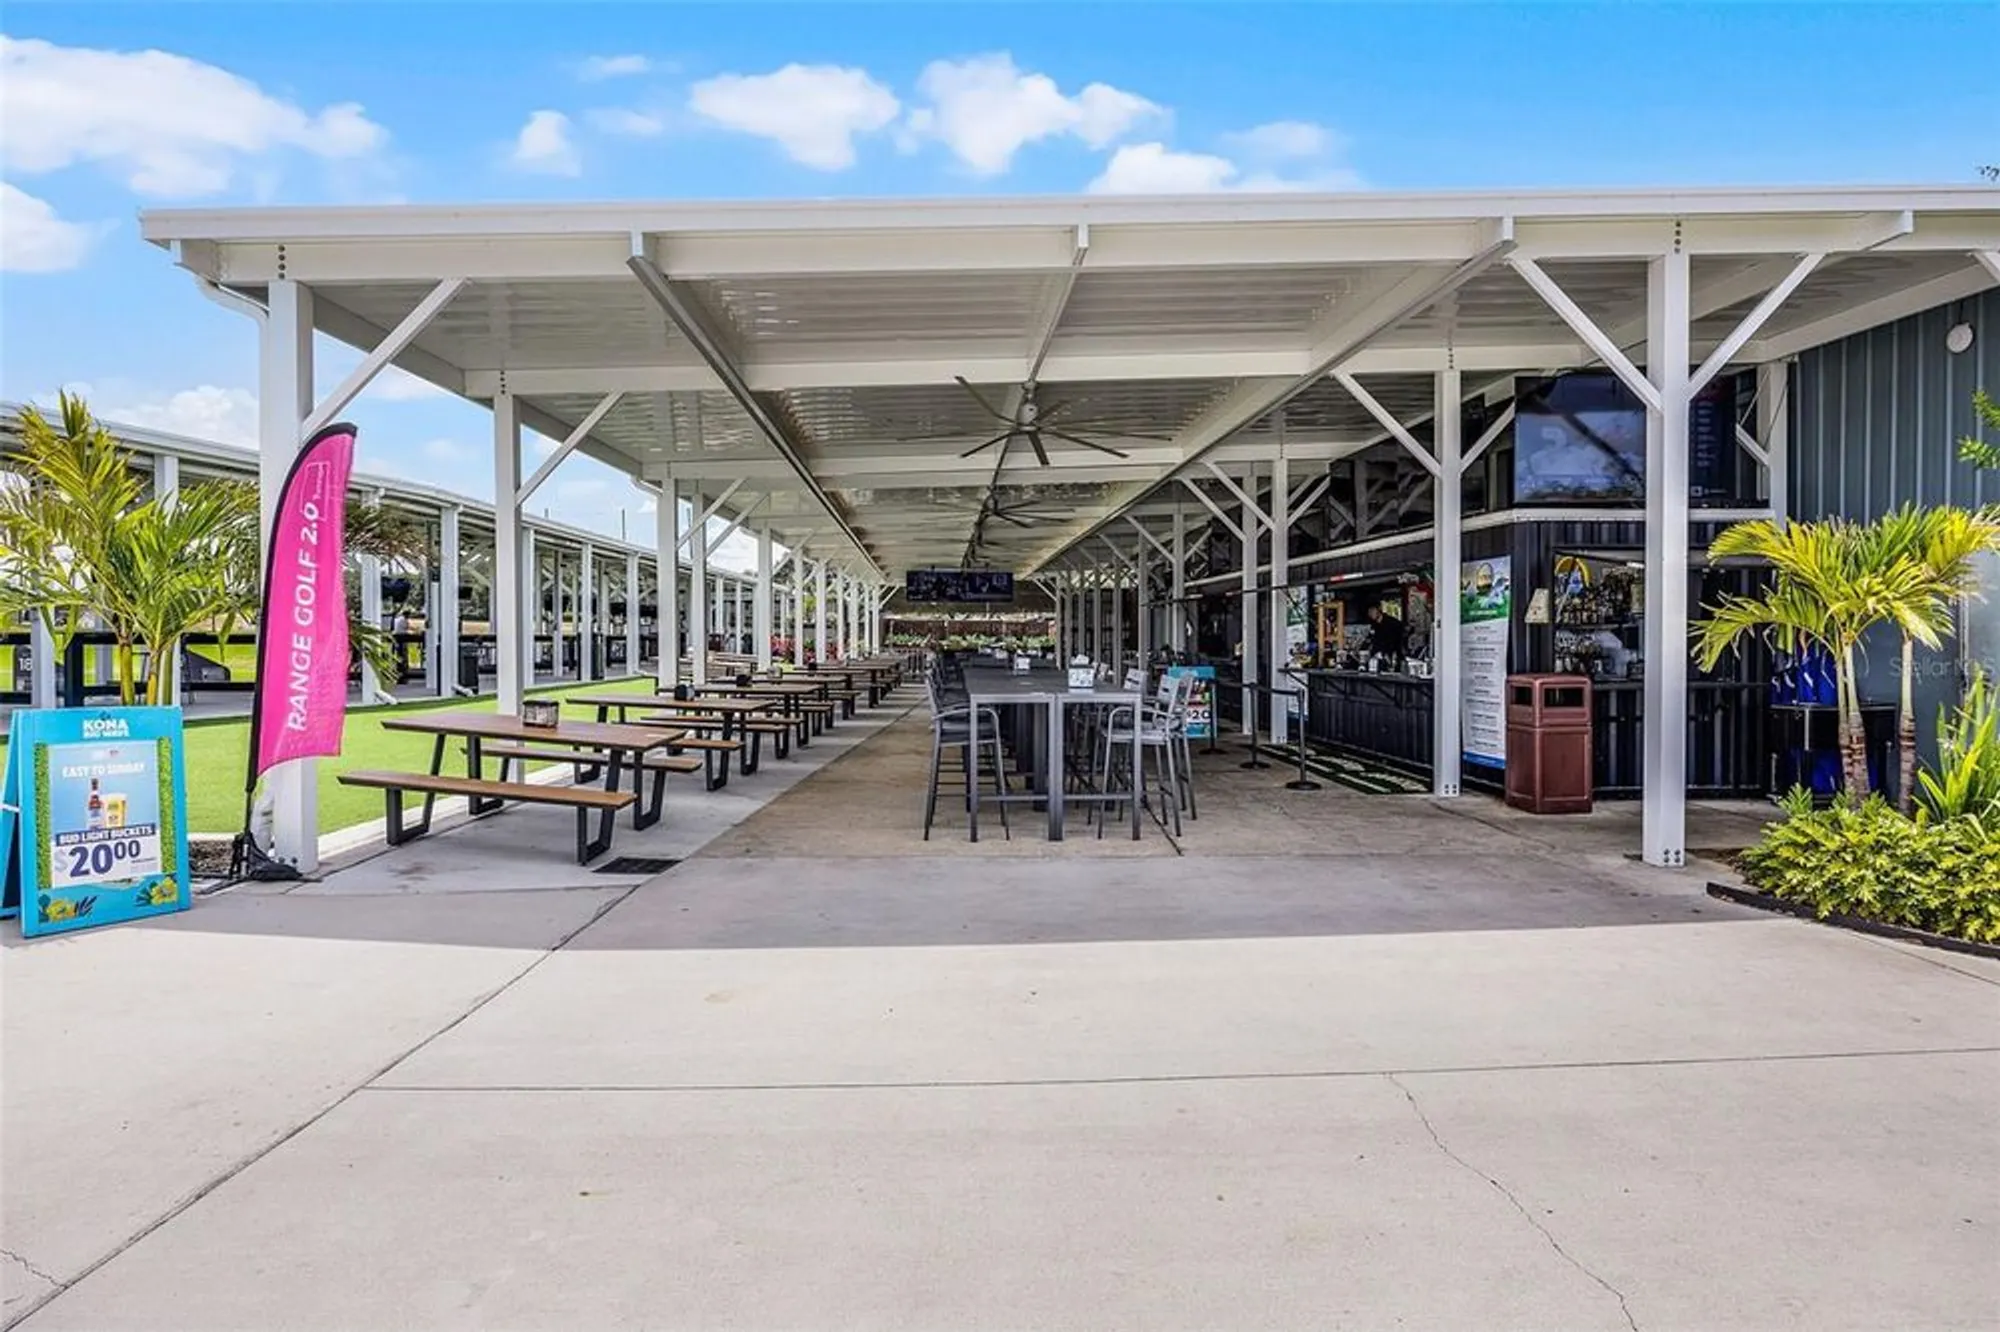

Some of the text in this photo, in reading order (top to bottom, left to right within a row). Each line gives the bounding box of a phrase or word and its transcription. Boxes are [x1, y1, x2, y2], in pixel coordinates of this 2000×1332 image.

[300, 502, 319, 545] 2.0
[294, 548, 318, 627] GOLF
[287, 632, 312, 731] RANGE
[83, 718, 129, 731] KONA
